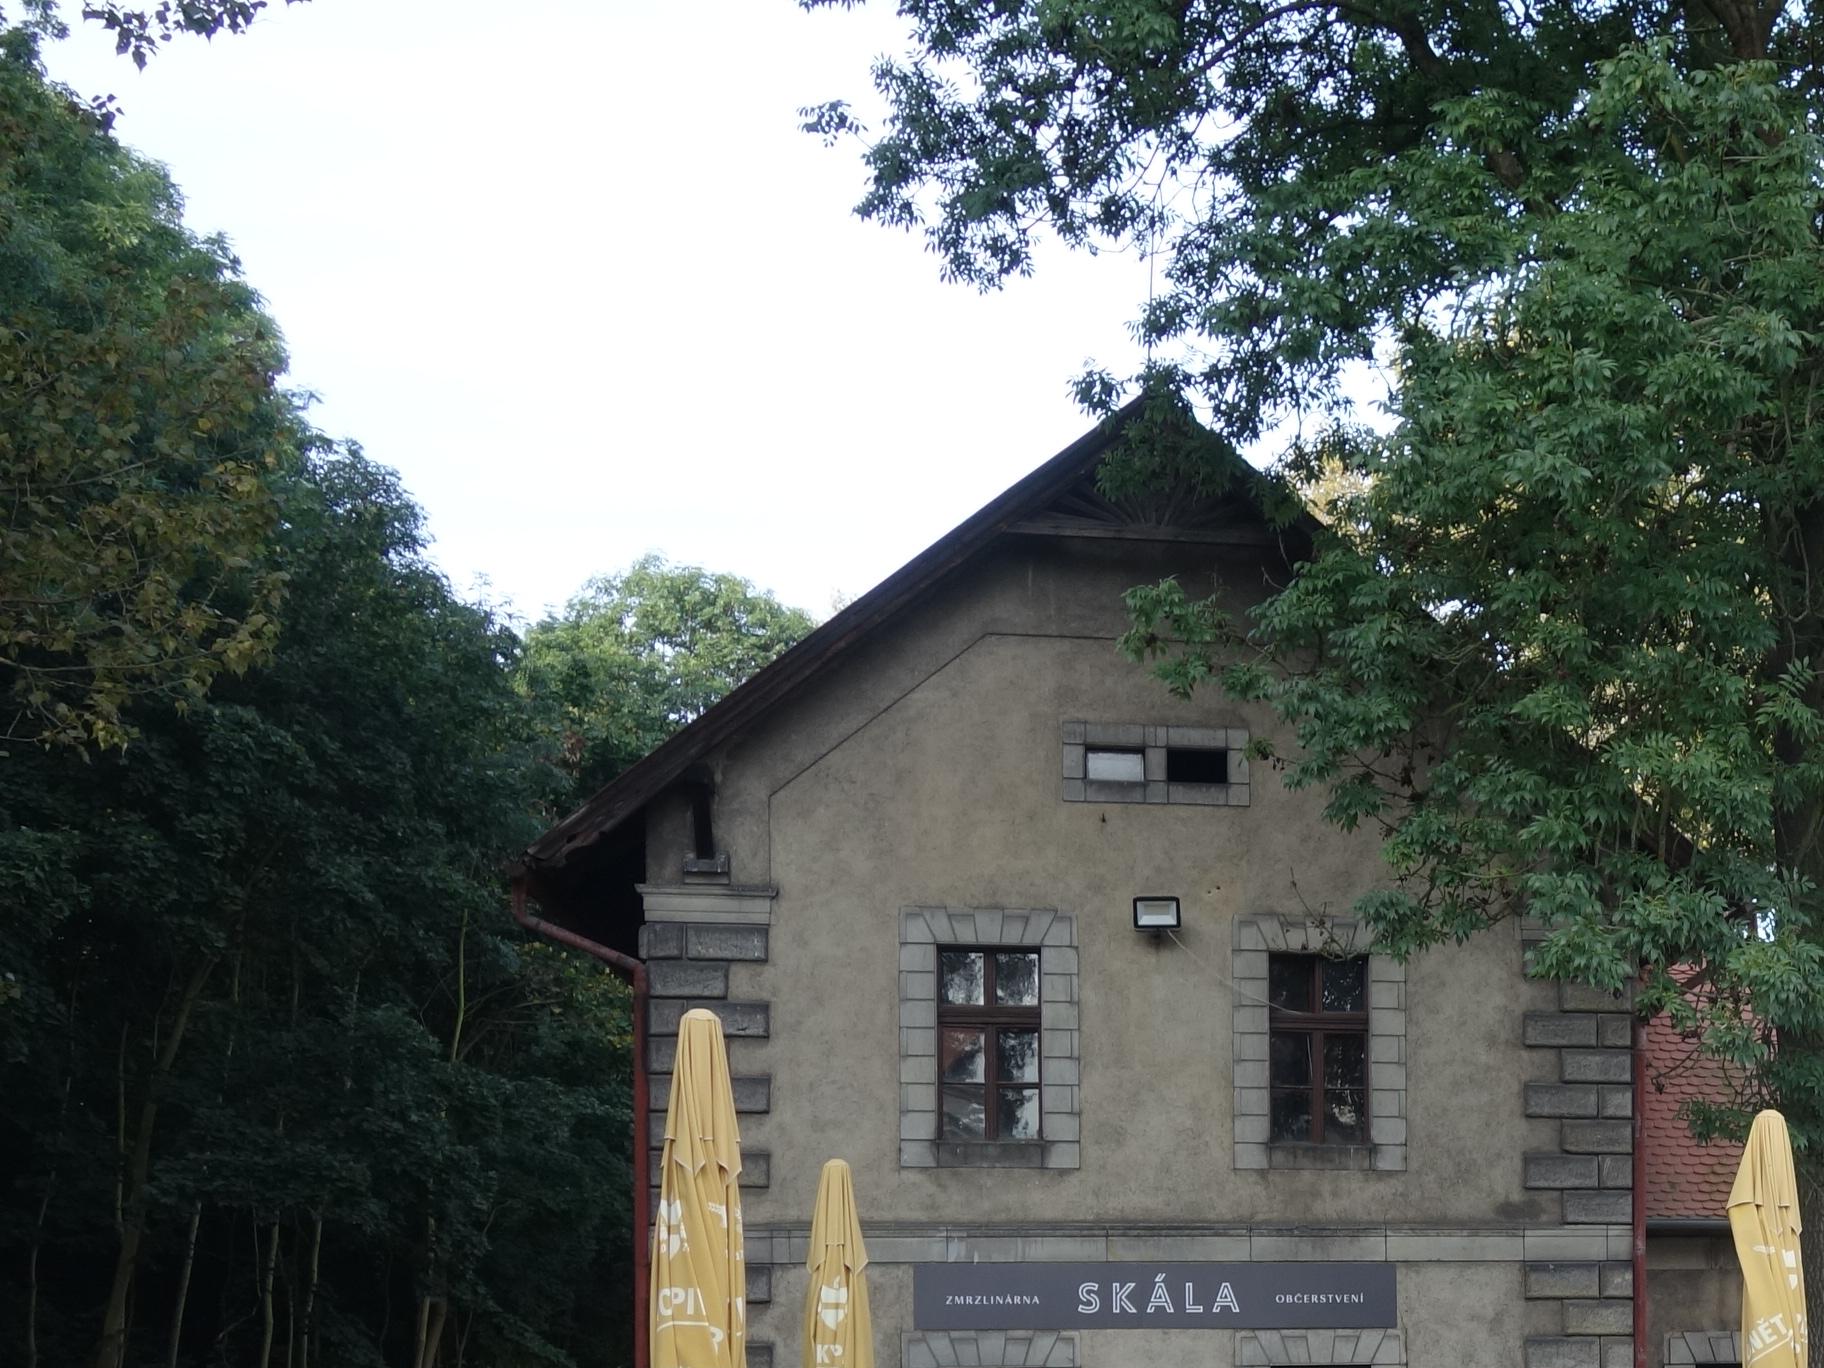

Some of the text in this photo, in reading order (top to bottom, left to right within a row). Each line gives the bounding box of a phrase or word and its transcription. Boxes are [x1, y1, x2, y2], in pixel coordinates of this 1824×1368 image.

[945, 1273, 1365, 1314] ZMRZLINÁRNA SKÁLA OBČERSTVENÍ
